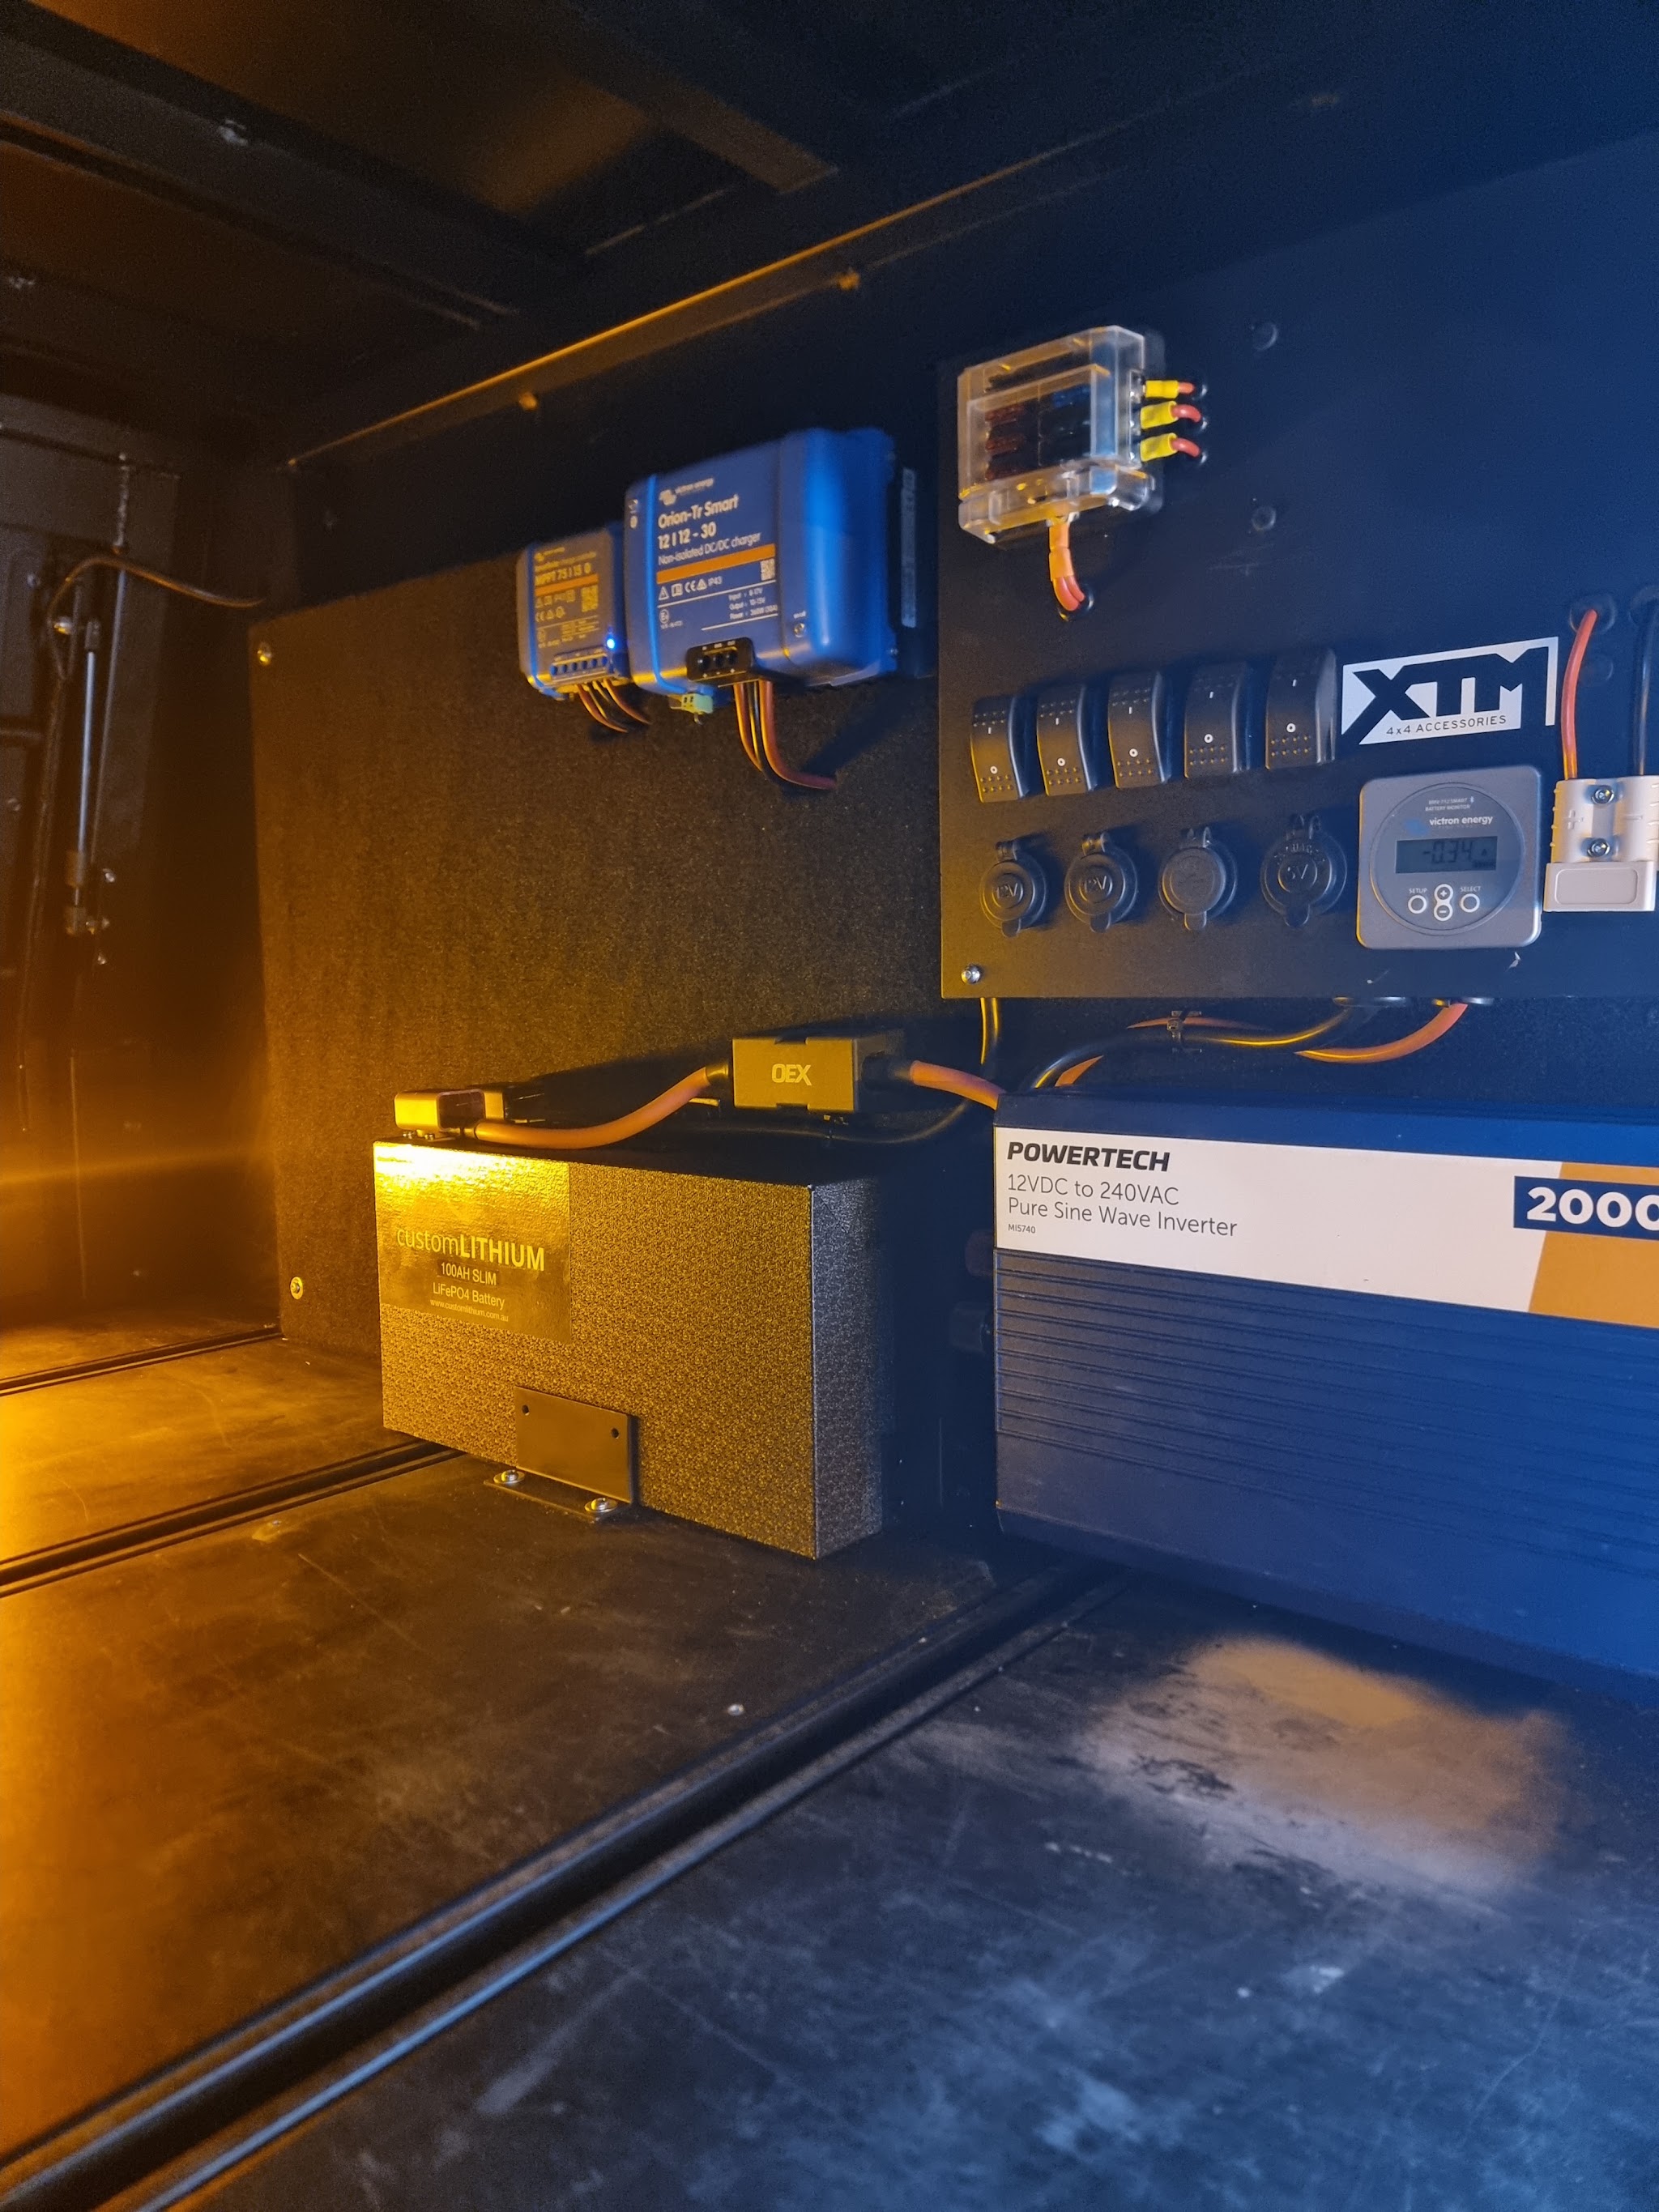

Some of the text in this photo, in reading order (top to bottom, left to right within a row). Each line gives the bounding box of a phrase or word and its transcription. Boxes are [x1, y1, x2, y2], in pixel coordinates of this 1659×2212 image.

[658, 494, 739, 528] Orion-Tr Smart
[701, 522, 716, 539] 30
[659, 532, 761, 565] Non-isolated DC/DC charger
[1341, 646, 1549, 744] XTM
[1386, 715, 1507, 736] 4x4 ACCESSORIES
[1429, 816, 1493, 826] victron energy
[771, 1063, 812, 1086] OEX
[1007, 1141, 1171, 1172] POWERTECH
[1008, 1174, 1179, 1205] 12VDC to 240VAC
[1009, 1197, 1238, 1237] Pure Sine Wave Inverter
[1527, 1187, 1659, 1231] 2000
[1008, 1224, 1036, 1234] MI5740
[397, 1229, 544, 1272] customLITHIUM
[441, 1262, 497, 1286] 100AH SLIM
[430, 1299, 509, 1322] www.customlithium.com.au
[433, 1282, 505, 1311] LiFePO4 Battery
